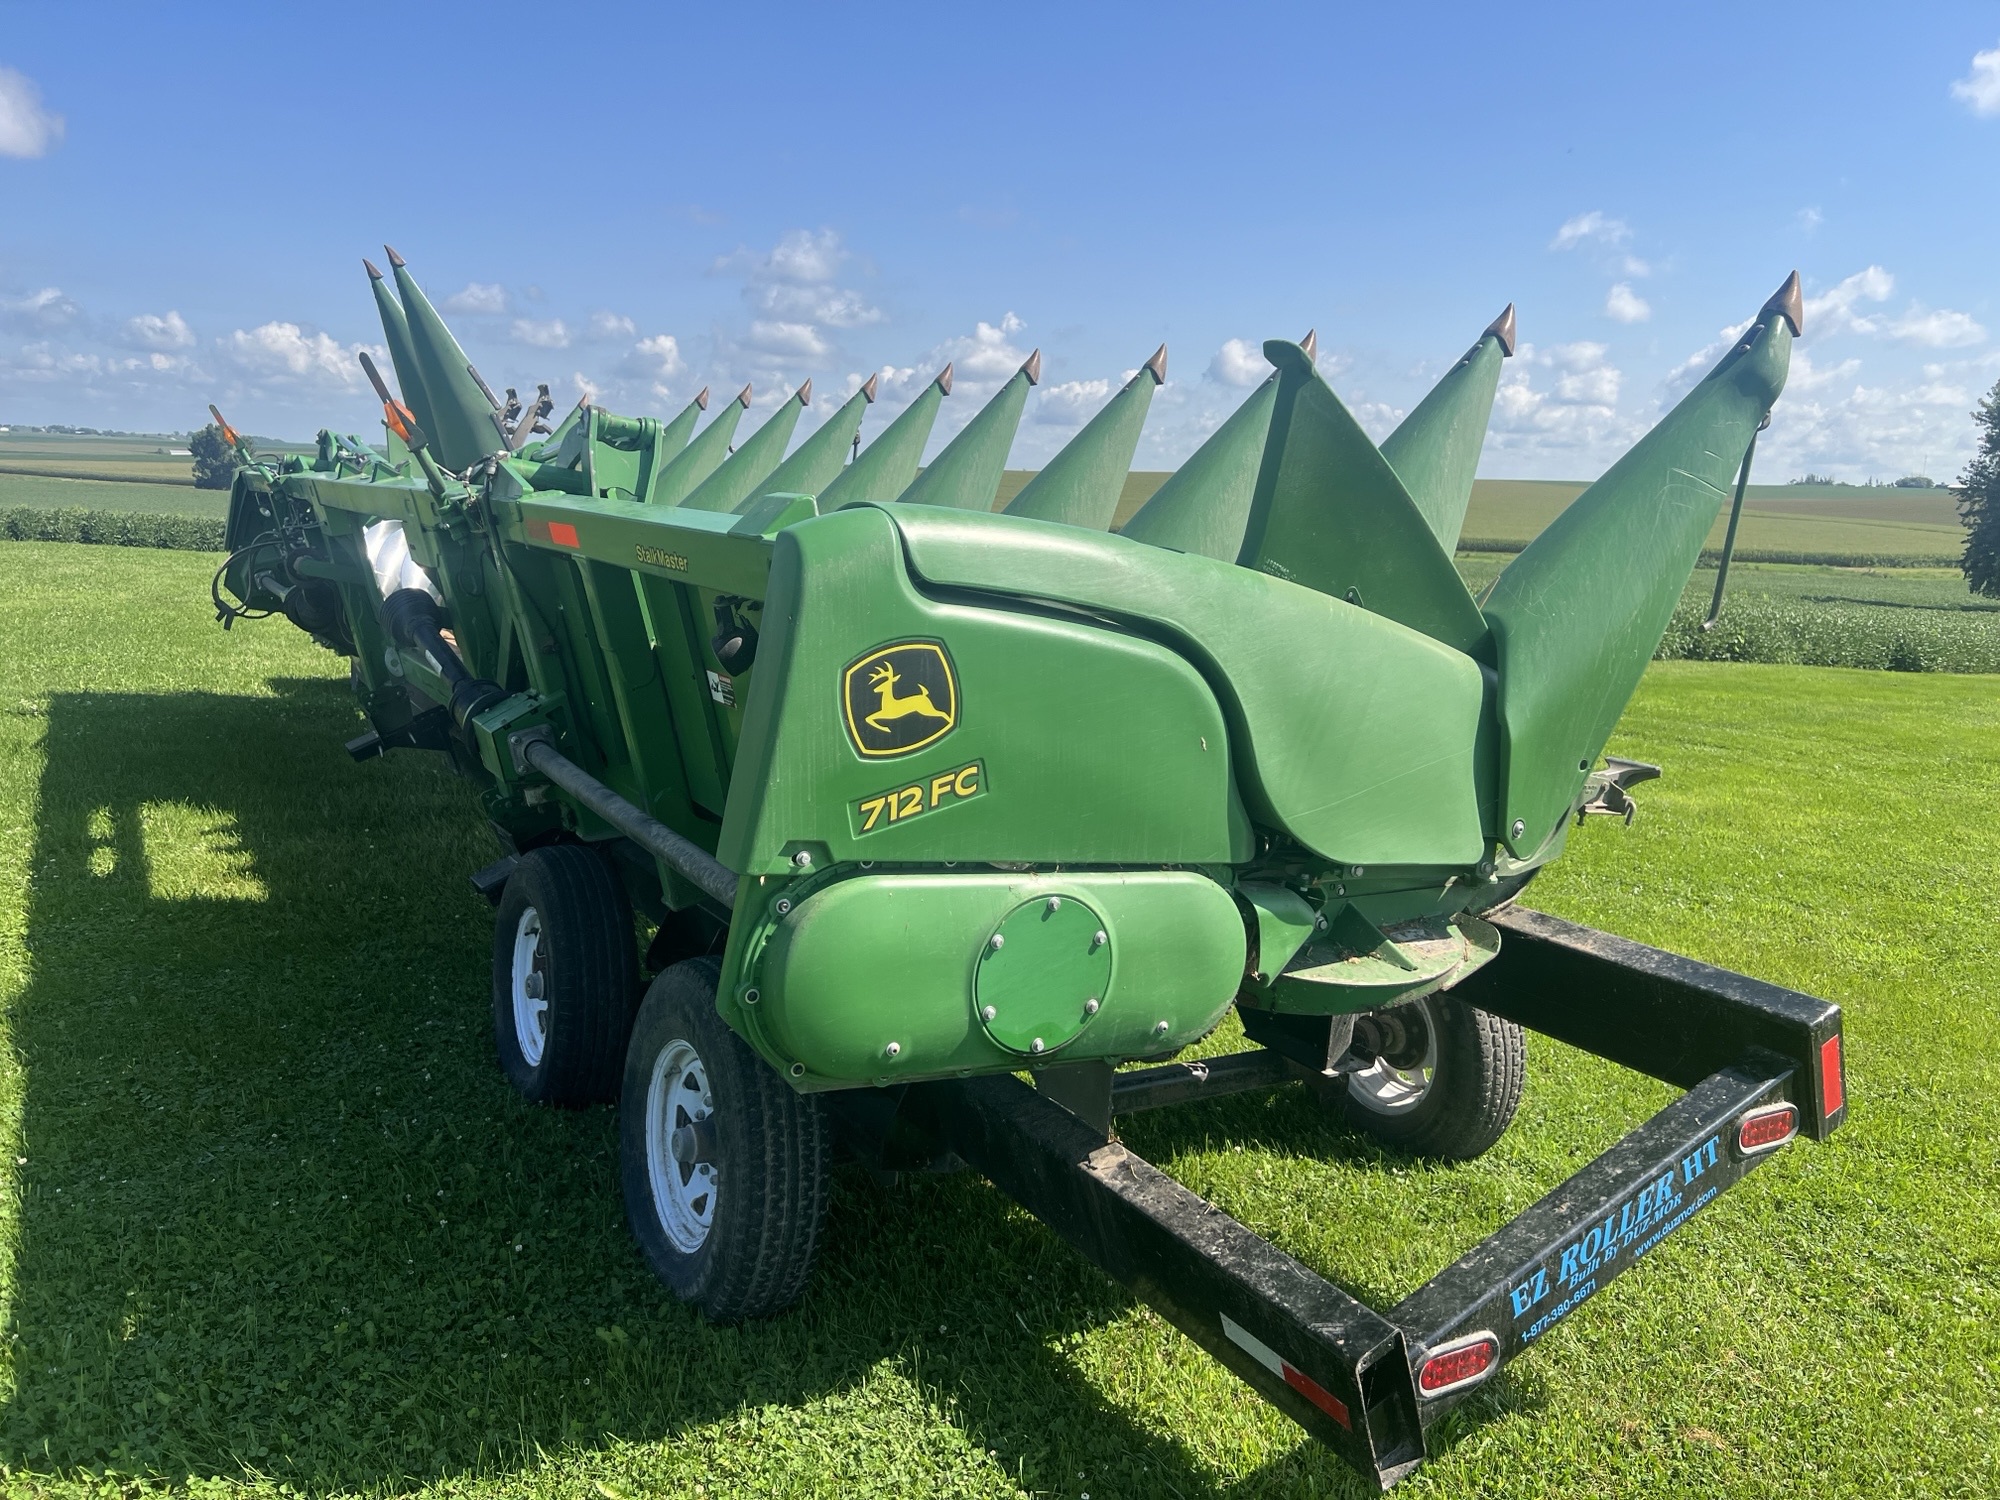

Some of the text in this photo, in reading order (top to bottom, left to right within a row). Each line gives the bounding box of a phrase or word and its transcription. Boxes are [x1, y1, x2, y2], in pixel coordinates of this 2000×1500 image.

[635, 545, 688, 571] StalkMaster
[859, 765, 979, 833] 712 FC
[1509, 1135, 1720, 1319] EZ ROLLER HT
[1521, 1186, 1717, 1343] 1-877-380-6671 www.duzmor.com
[1568, 1192, 1683, 1290] Built By DUZ-MOR
